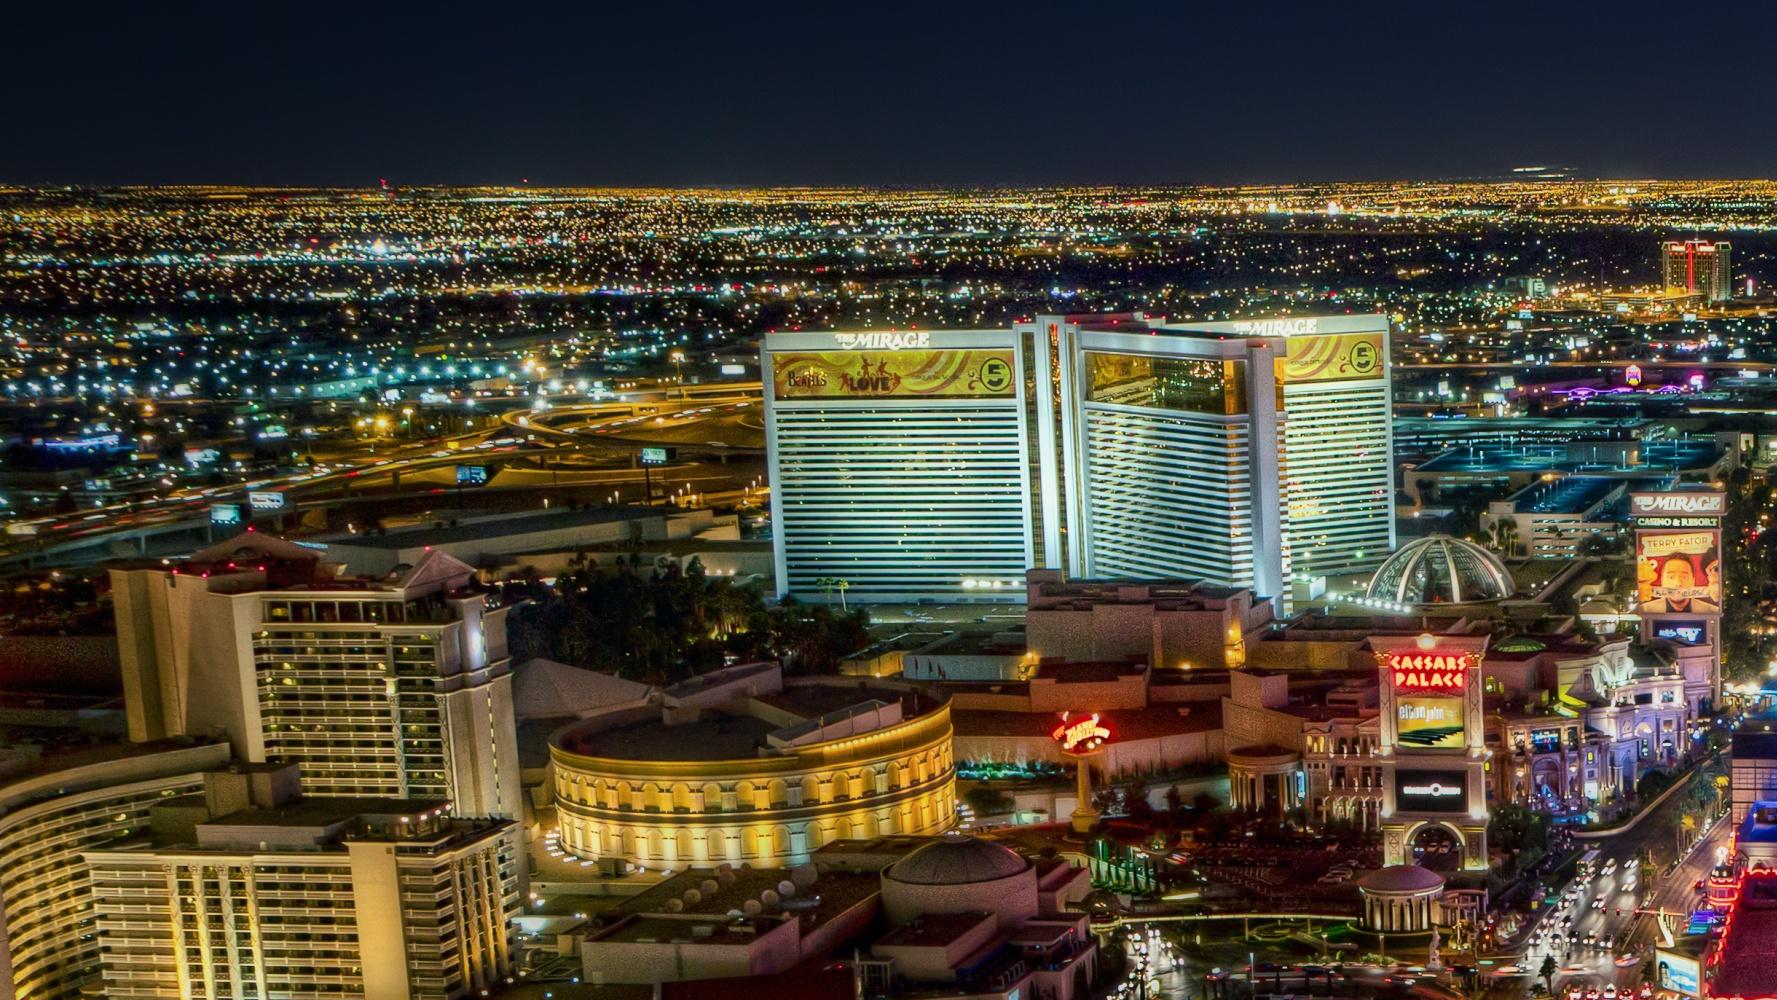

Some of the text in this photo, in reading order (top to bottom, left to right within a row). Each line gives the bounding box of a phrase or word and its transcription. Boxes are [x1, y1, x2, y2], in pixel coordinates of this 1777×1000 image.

[1248, 318, 1318, 338] MIRAGE
[847, 332, 931, 351] MIRAGE
[850, 376, 890, 392] LOVE
[1645, 495, 1721, 513] MIRAGE
[1637, 517, 1719, 527] CASINO & RESORT
[1648, 536, 1708, 548] TERRY FATOR
[1390, 655, 1468, 671] CAESARS
[1395, 672, 1464, 688] PALACE
[1399, 704, 1426, 721] elton
